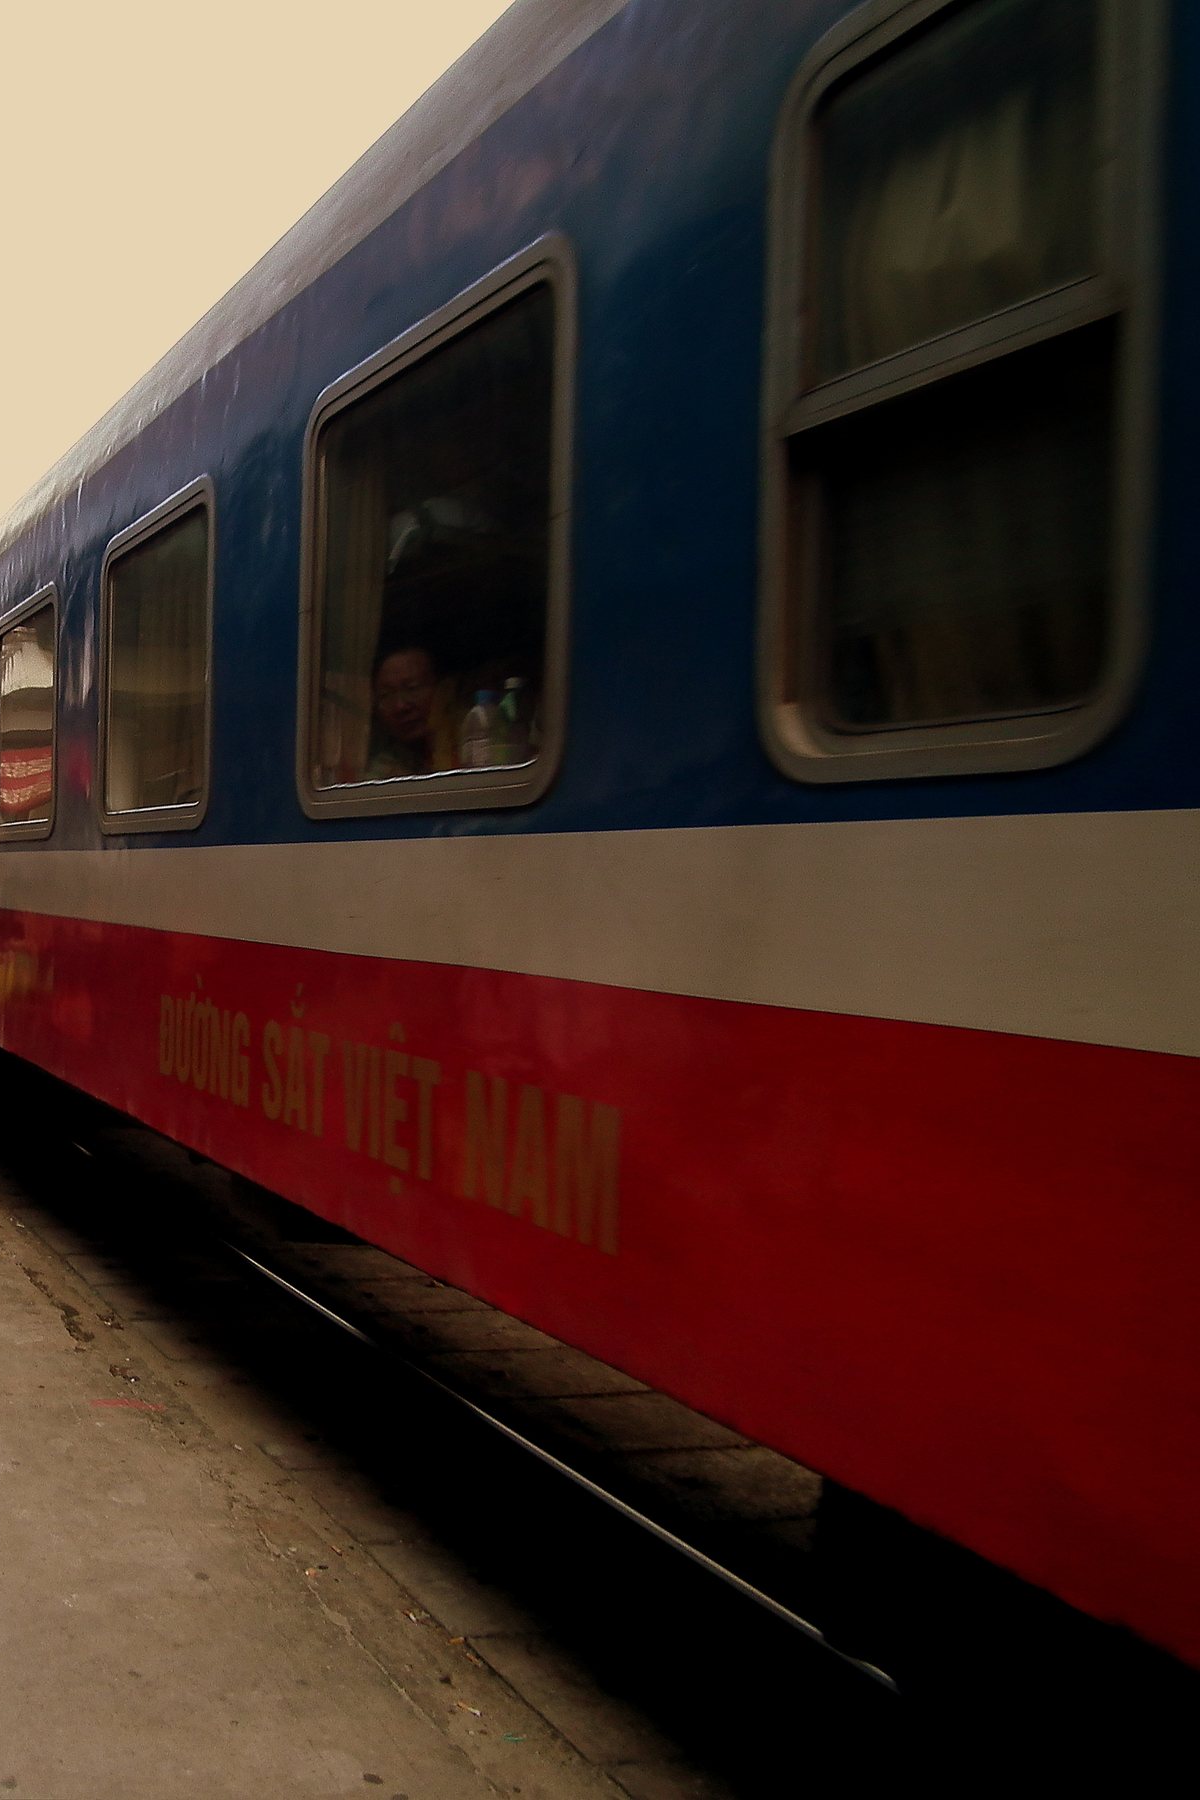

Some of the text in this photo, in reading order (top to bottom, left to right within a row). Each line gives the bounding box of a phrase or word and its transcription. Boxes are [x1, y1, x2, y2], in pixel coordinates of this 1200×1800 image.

[262, 982, 331, 1138] SẮT
[342, 1021, 443, 1196] VIỆT
[460, 1069, 624, 1257] NAM
